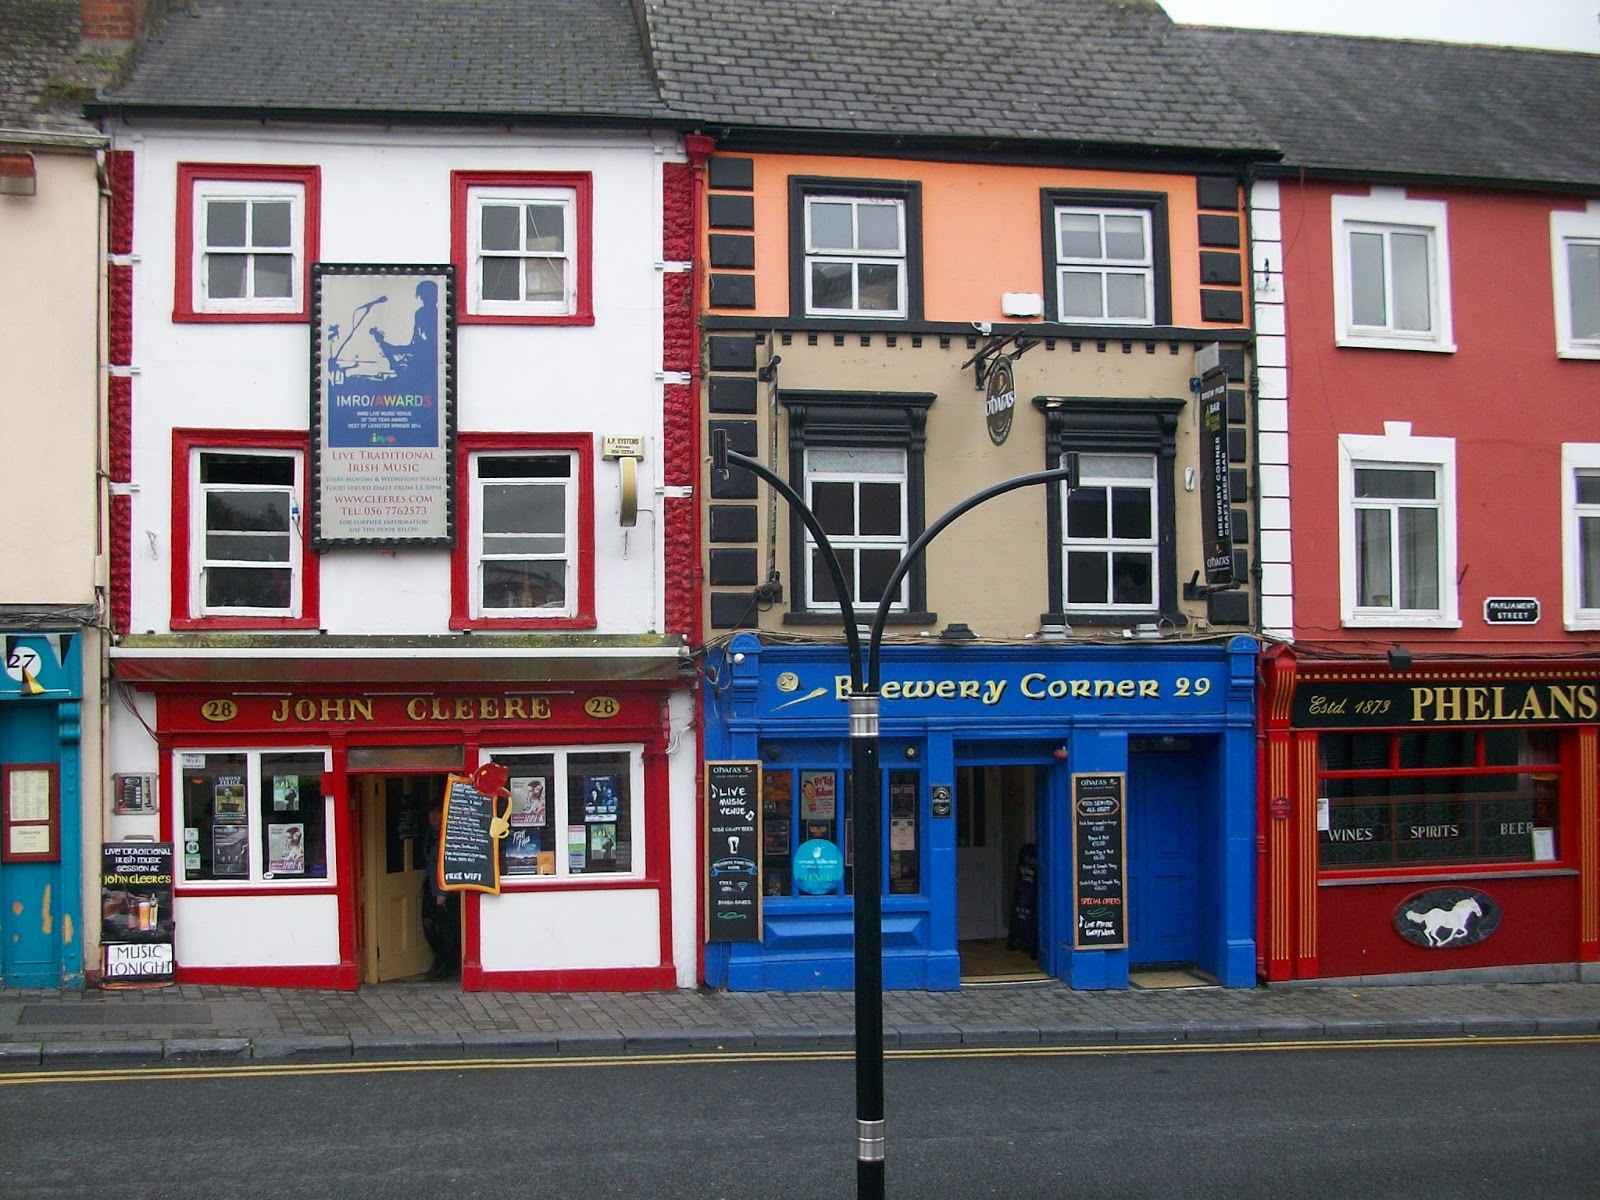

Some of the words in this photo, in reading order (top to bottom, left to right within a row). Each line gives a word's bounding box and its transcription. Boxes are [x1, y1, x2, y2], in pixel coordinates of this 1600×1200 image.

[1201, 390, 1214, 400] BREW
[1214, 385, 1224, 394] PUB
[336, 394, 432, 408] IMRO/AWARDS
[1210, 402, 1220, 414] BAR
[332, 451, 354, 460] LIVE
[359, 450, 436, 460] TRADITIONAL
[348, 463, 379, 472] IRISH
[382, 463, 420, 472] MUSIC
[334, 495, 433, 504] WWW.CLEERES.COM
[364, 506, 382, 516] 056
[386, 506, 428, 516] 7762573
[1216, 484, 1224, 537] BREWERY
[7, 654, 36, 668] 27
[1020, 673, 1160, 698] Corner
[1173, 677, 1211, 696] 29
[208, 702, 232, 716] 28
[271, 699, 374, 722] JOHN
[406, 698, 552, 720] CLEERE
[591, 698, 615, 714] 28
[1308, 694, 1347, 715] Estd.
[1354, 699, 1391, 714] 1873
[1410, 685, 1599, 722] PHELANS
[720, 786, 747, 796] LIVE
[719, 798, 746, 806] MUSIC
[1328, 828, 1372, 842] WINES
[1410, 824, 1459, 839] SPIRITS
[446, 872, 462, 880] FREE
[117, 945, 162, 959] MUSIC
[109, 960, 172, 976] TONIGHT
